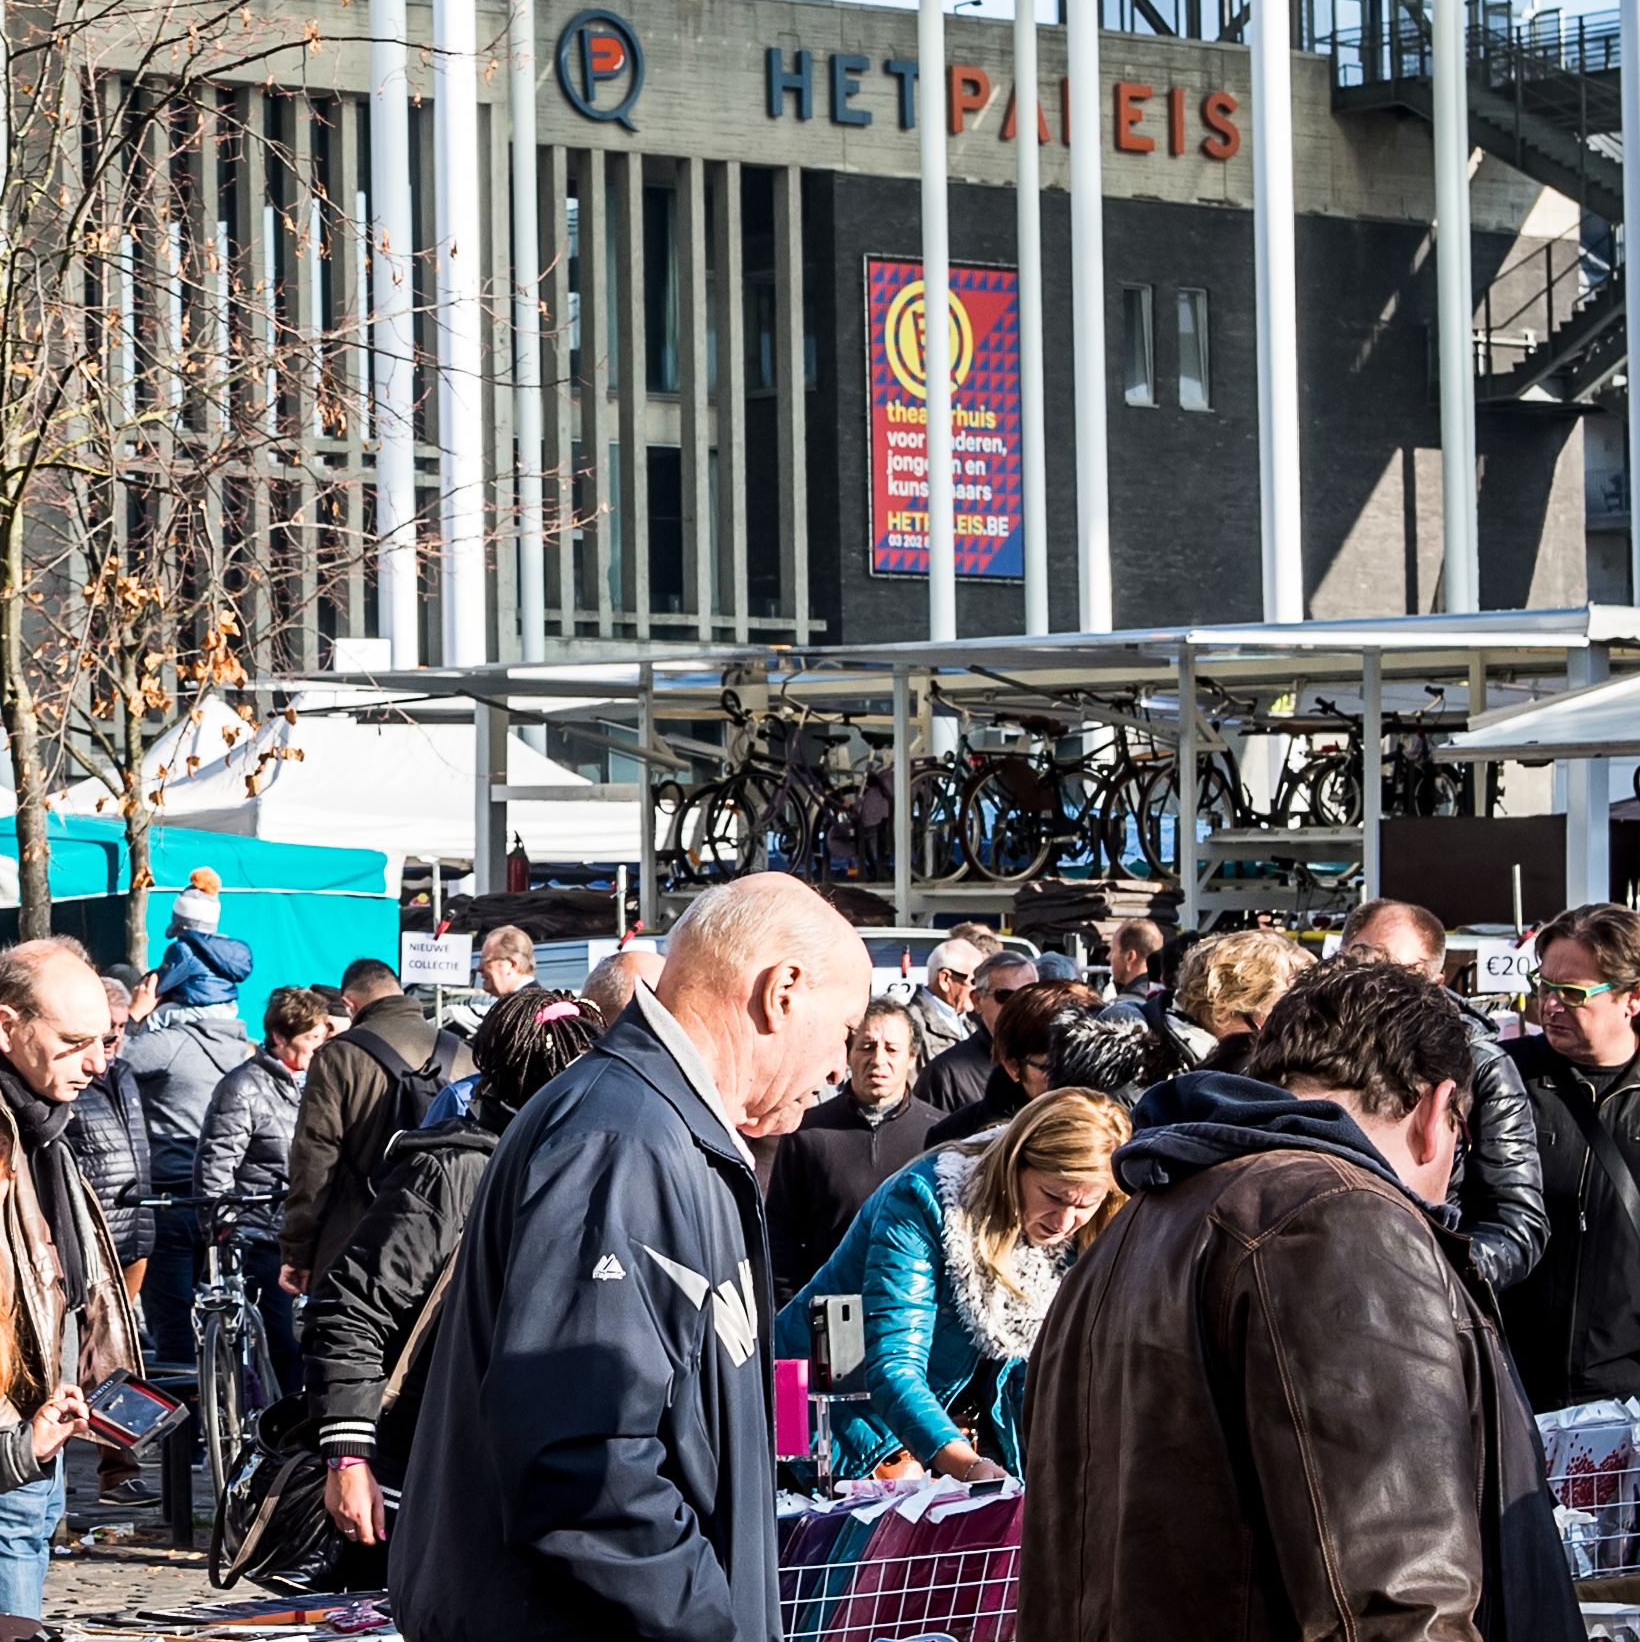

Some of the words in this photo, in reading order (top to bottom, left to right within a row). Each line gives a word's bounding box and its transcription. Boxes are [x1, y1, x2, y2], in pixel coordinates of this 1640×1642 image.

[887, 431, 925, 448] voor
[965, 459, 986, 476] en
[409, 943, 449, 953] NIEUWE
[409, 960, 459, 970] COLLECTIE
[1486, 956, 1530, 976] €20
